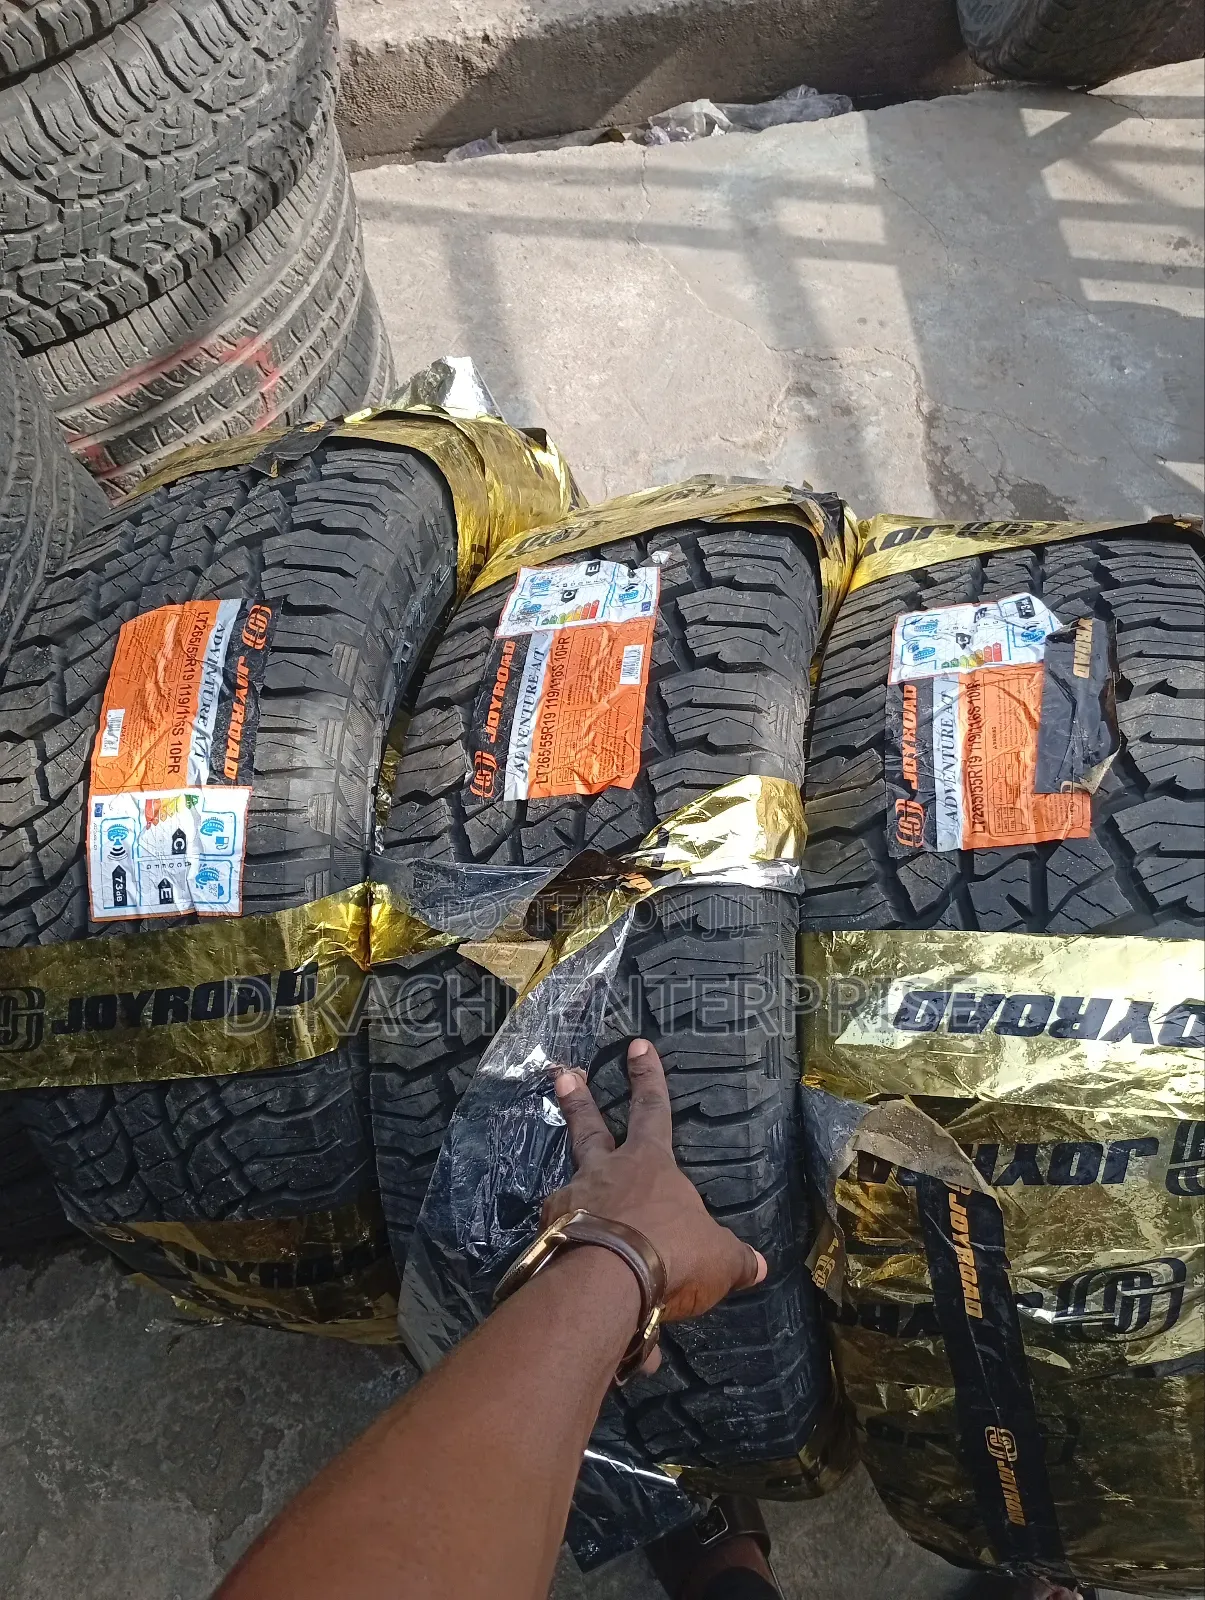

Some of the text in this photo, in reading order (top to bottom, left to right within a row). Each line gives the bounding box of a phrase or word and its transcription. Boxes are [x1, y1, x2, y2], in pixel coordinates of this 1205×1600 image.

[182, 611, 209, 681] LT265/55R19
[485, 640, 516, 744] JOYROAD
[167, 741, 183, 775] 10PR
[223, 655, 250, 780] JOYROAD
[513, 673, 539, 776] ADVENTURE
[535, 636, 571, 785] LT265/55R19 119/116S 10PR
[901, 684, 918, 791] JOYROAD
[940, 717, 959, 820] ADVENTURE
[967, 755, 986, 835] LT265/55R19
[114, 877, 123, 902] 73dB
[51, 961, 319, 1035] JOYROAD
[948, 1192, 984, 1319] JOYROAD
